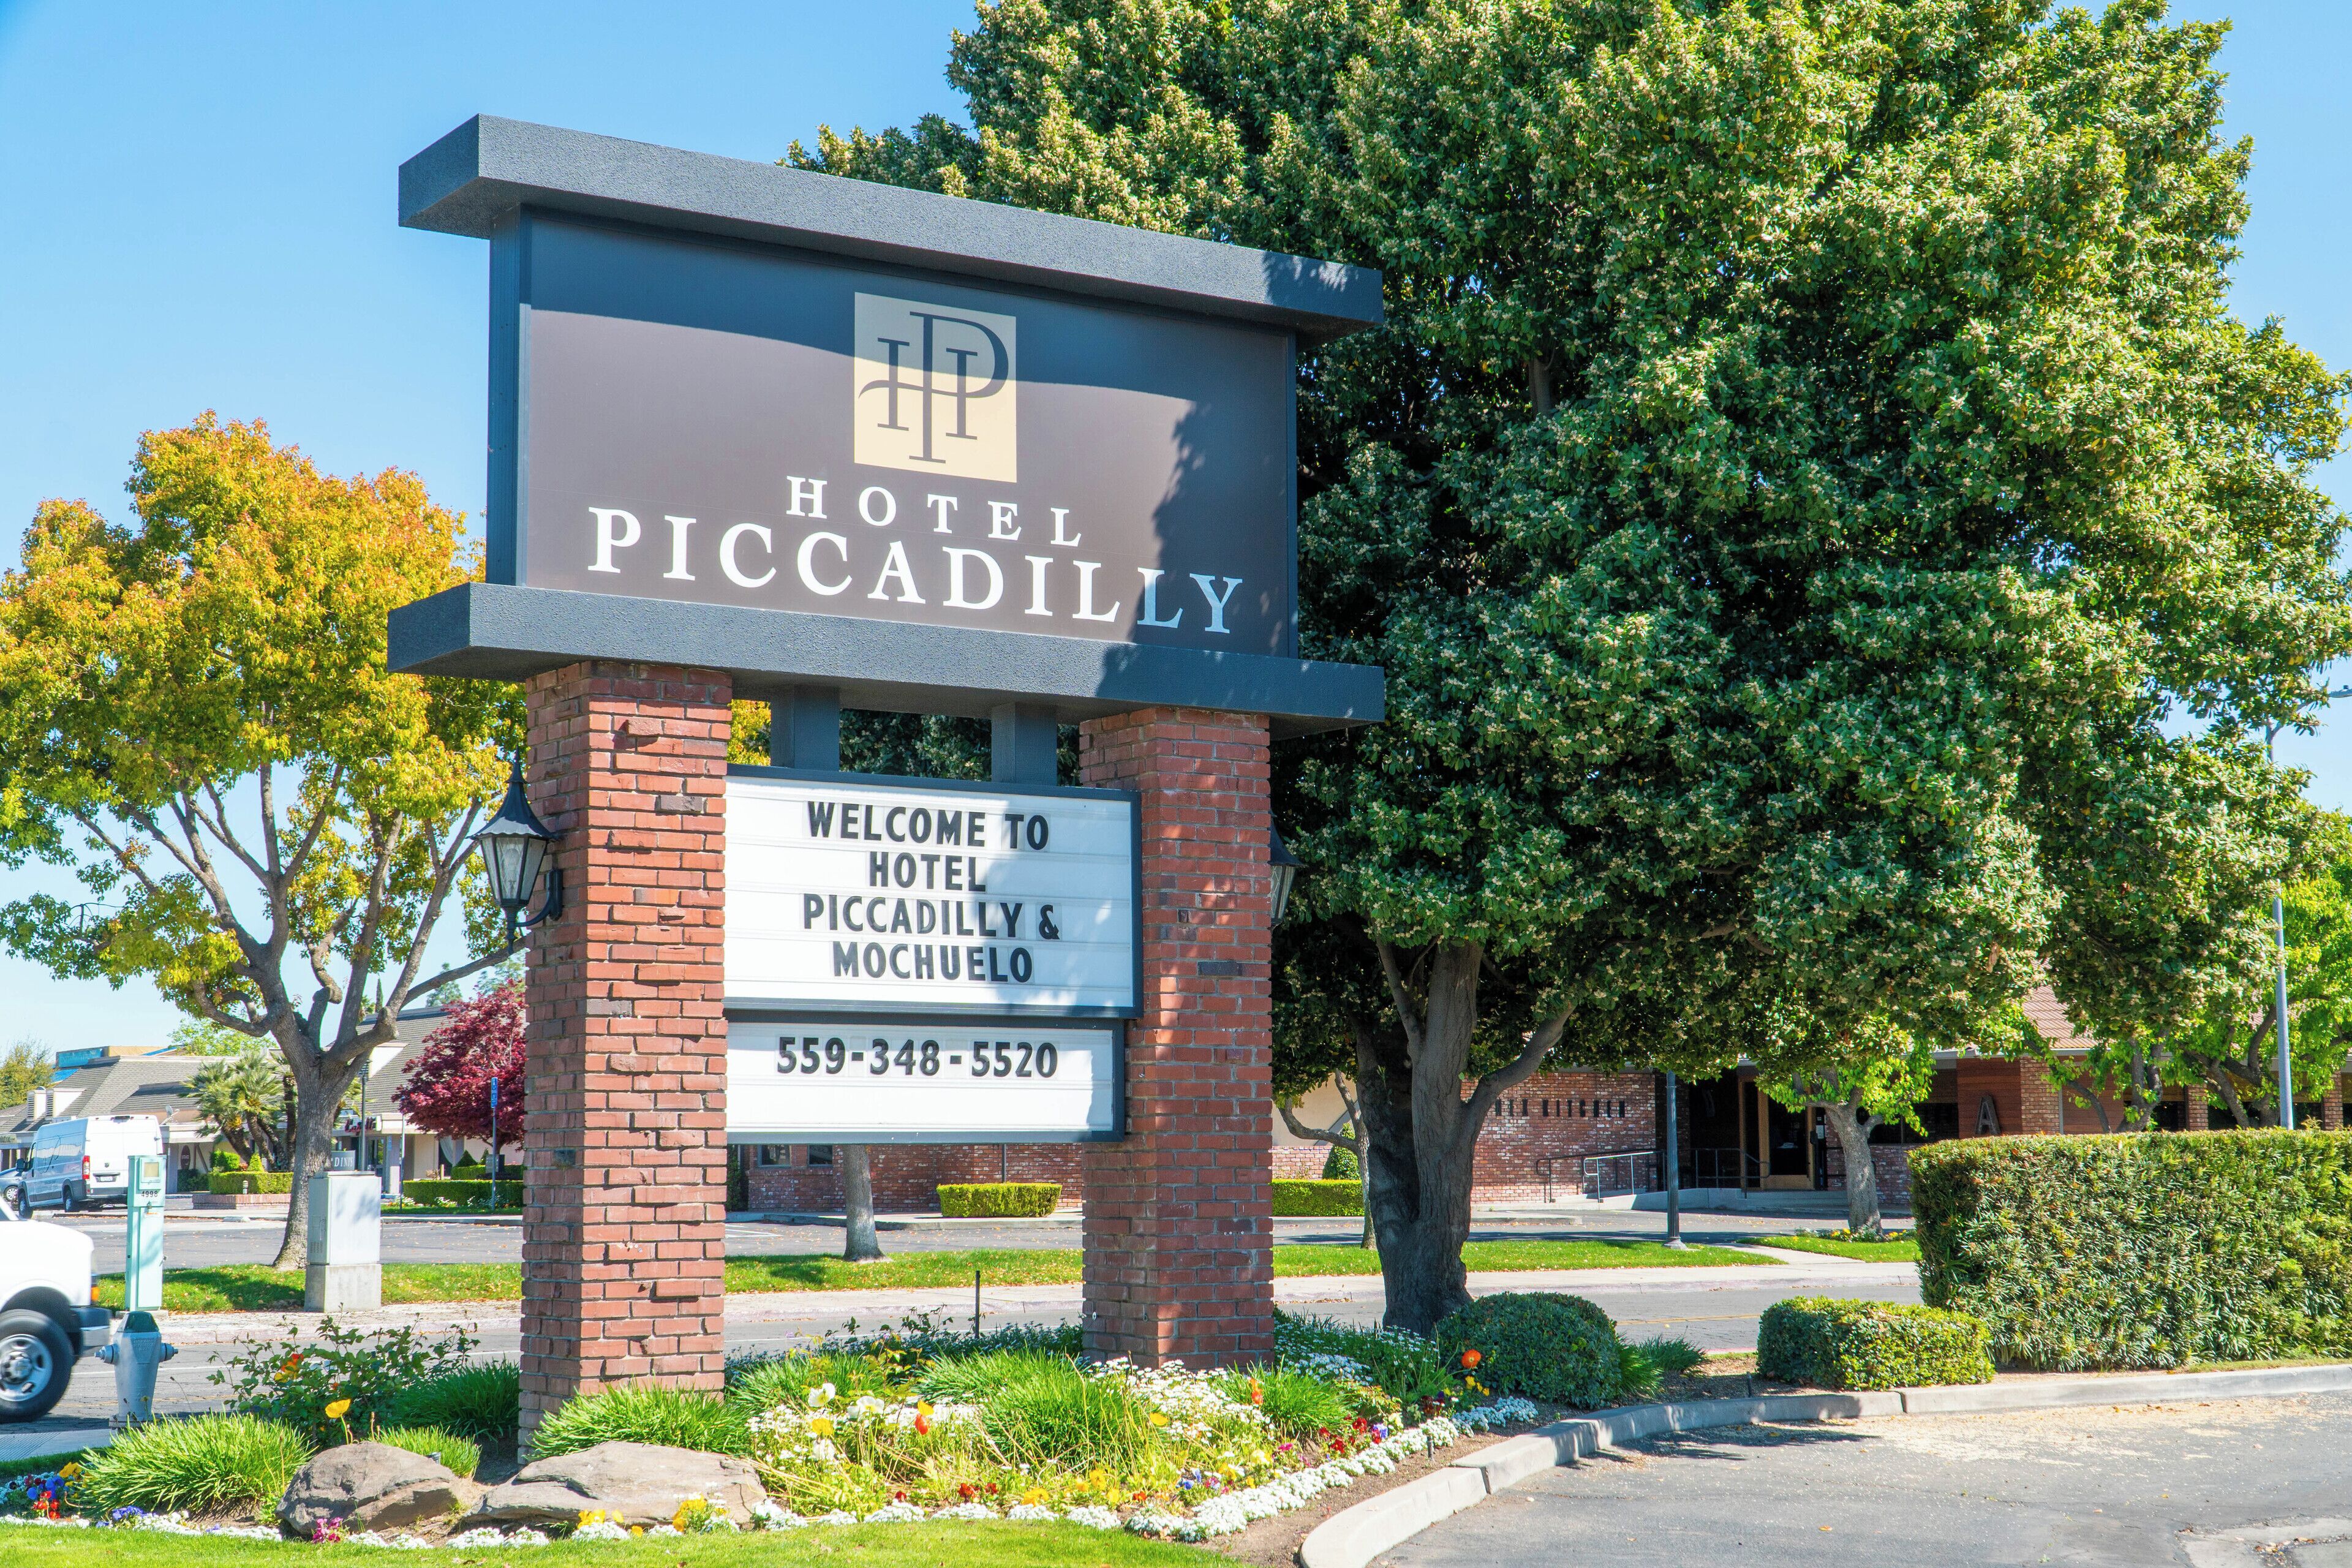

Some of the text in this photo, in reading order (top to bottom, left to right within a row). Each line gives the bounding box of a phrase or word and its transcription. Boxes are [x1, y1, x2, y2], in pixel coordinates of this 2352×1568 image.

[786, 475, 1082, 548] HOTEL
[587, 506, 1243, 635] PICCADILLY
[807, 801, 1049, 850] WELCOME TO
[869, 851, 986, 892] HOTEL
[803, 893, 1061, 940] PICCADILLY &
[832, 940, 1033, 983] MOCHUELO
[777, 1036, 1058, 1079] 559-348-5520
